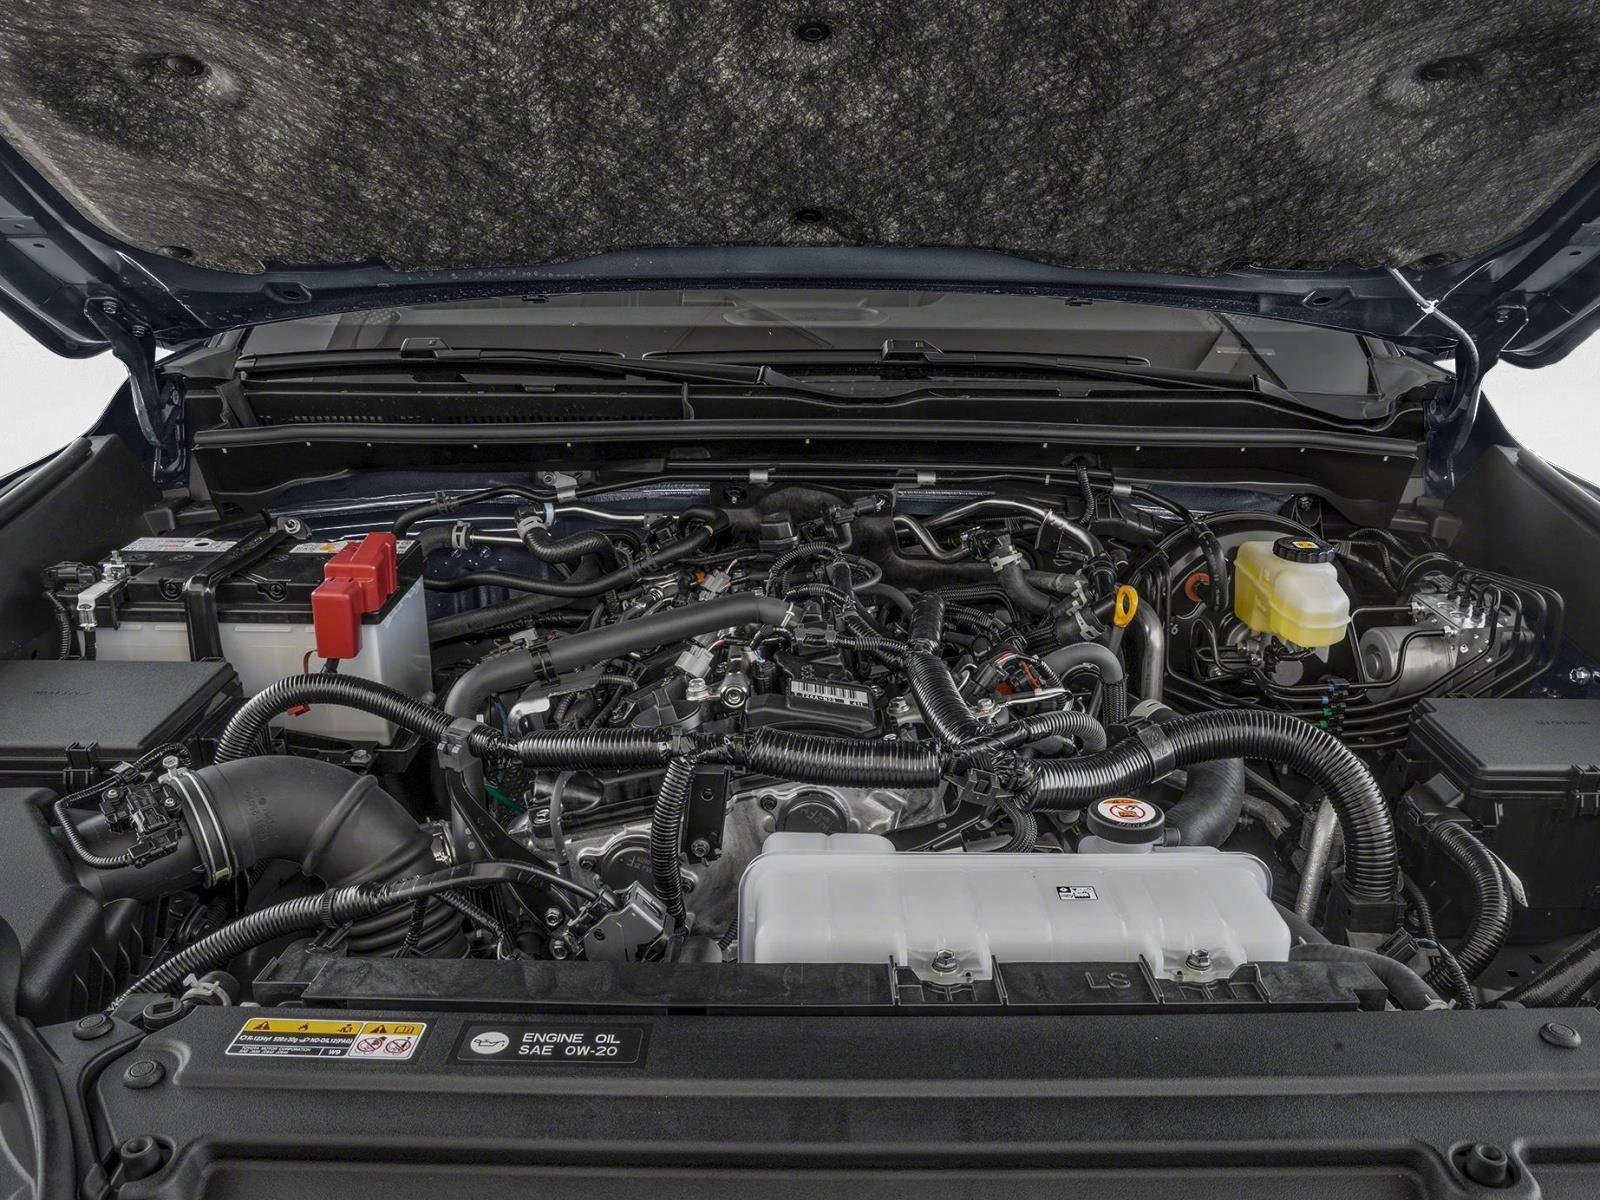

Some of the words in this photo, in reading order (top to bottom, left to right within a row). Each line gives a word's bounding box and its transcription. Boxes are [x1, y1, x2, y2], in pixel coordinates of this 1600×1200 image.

[522, 1032, 584, 1043] ENGINE
[594, 1033, 621, 1044] OIL
[518, 1045, 553, 1055] SAE
[565, 1045, 618, 1056] 0W-20
